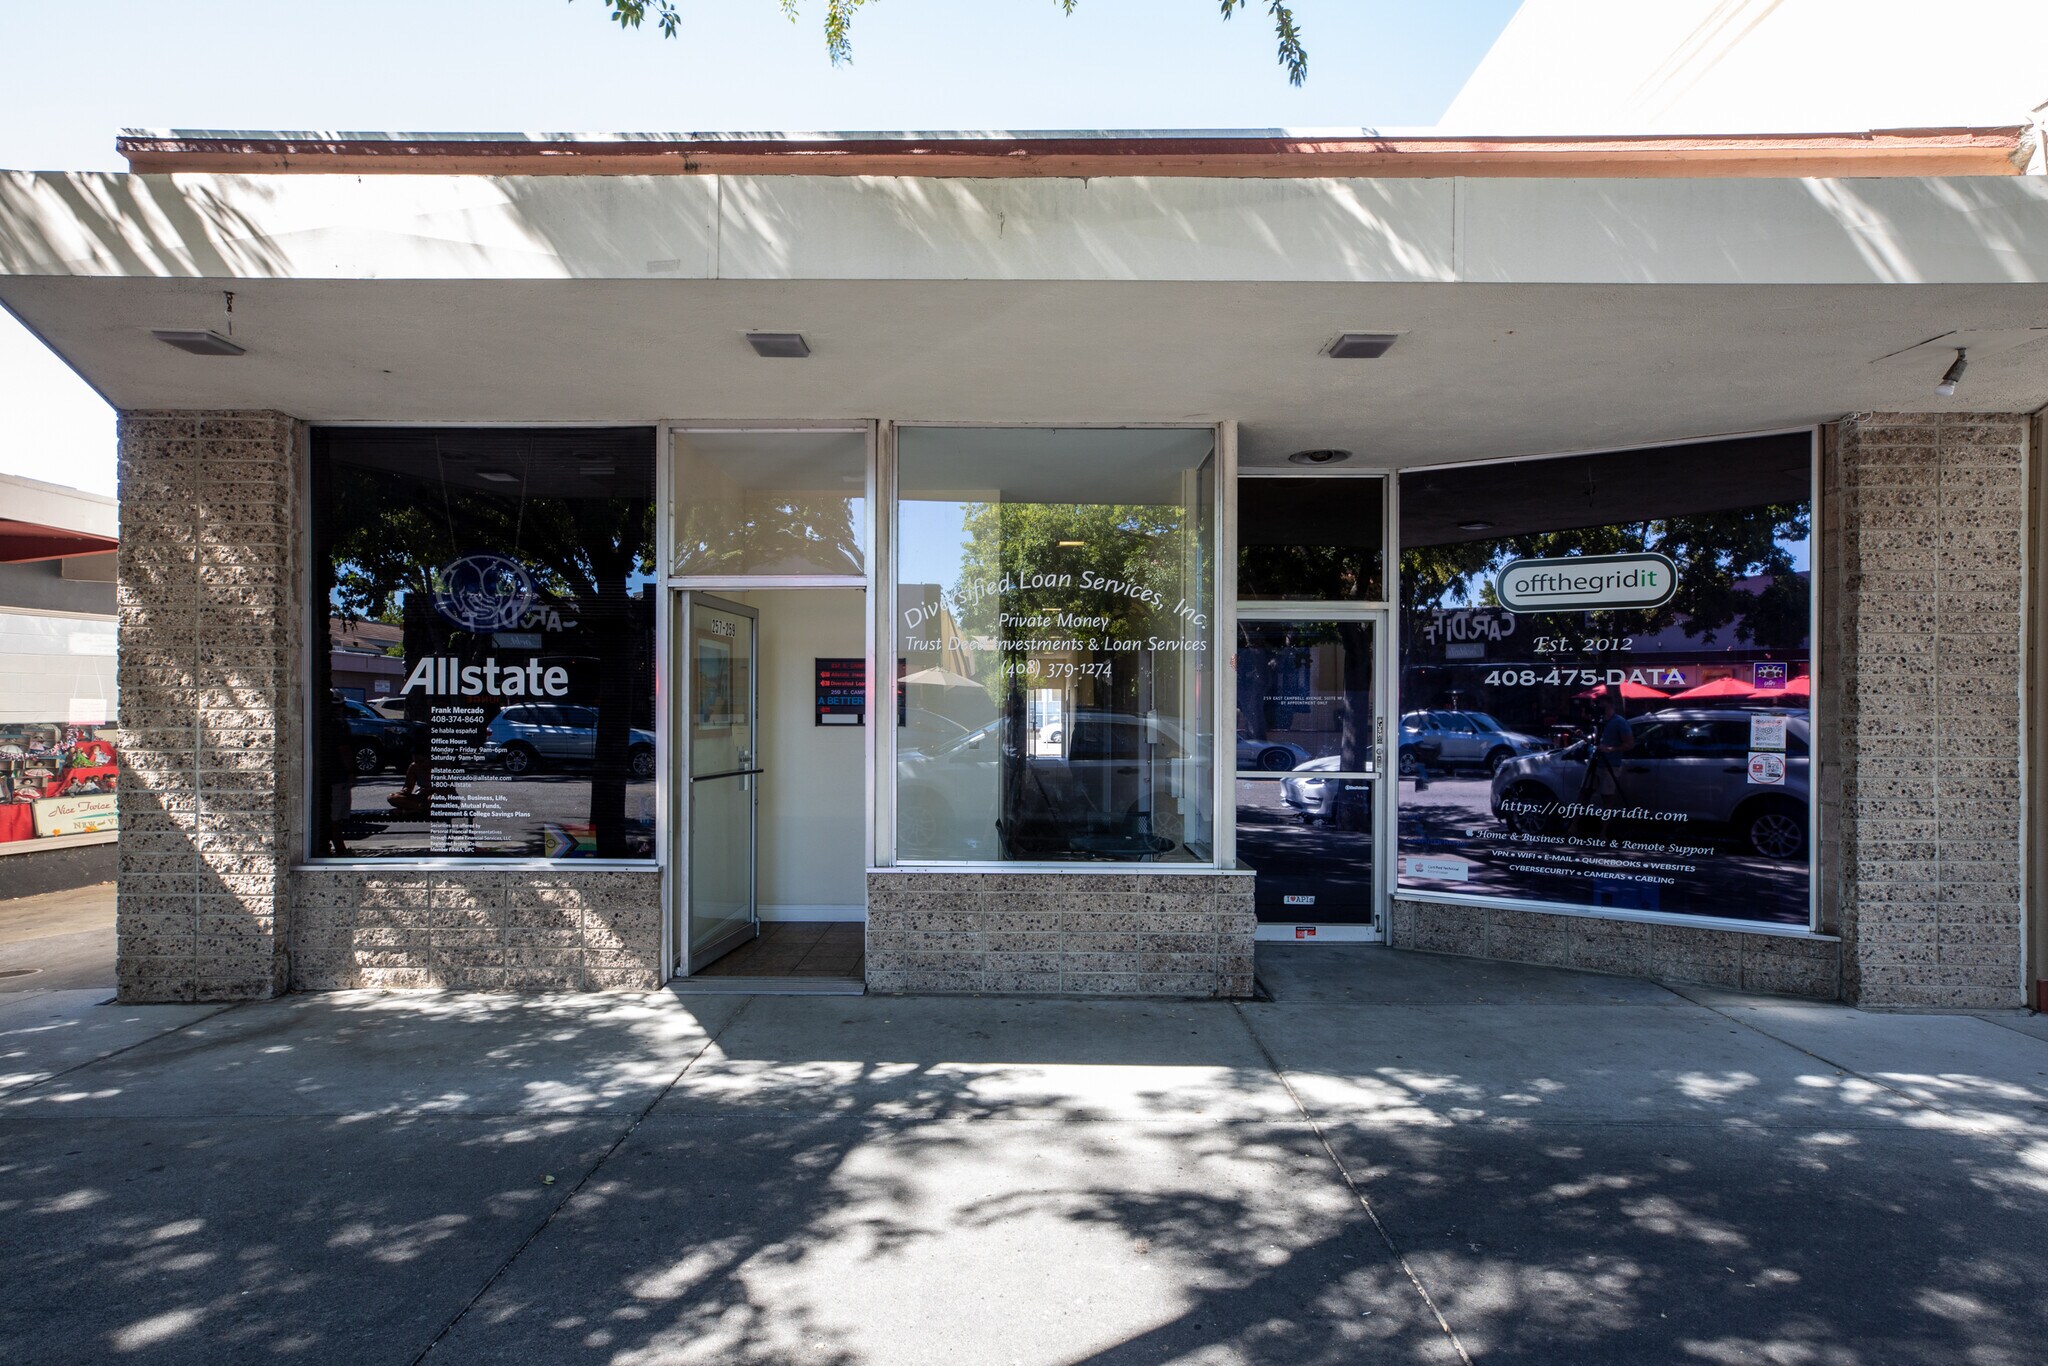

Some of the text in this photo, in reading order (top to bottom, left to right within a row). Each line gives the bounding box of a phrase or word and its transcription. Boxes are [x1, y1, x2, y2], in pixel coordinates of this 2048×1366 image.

[1515, 569, 1658, 597] offthegridit
[904, 570, 1209, 630] Diversified Loan Services, Inc.
[712, 619, 736, 637] 257-259
[999, 613, 1109, 632] Private Money
[906, 636, 942, 651] Trust
[1088, 637, 1100, 650] &
[1104, 636, 1141, 651] Loan
[1147, 636, 1207, 651] Services
[1533, 636, 1633, 652] Est. 2012
[400, 657, 569, 696] Allstate
[1000, 659, 1112, 679] (408) 379-1274
[1484, 668, 1686, 687] 408-475-DATA
[431, 706, 484, 714] Frank Mercado
[818, 697, 864, 705] A BETTER
[456, 727, 478, 735] español
[48, 801, 111, 818] Nice Twice
[1500, 799, 1689, 822] https://offthegridit.com
[1476, 830, 1714, 856] Home & Business On-Site & Remote Support
[1491, 850, 1509, 858] VPN
[1544, 854, 1573, 863] E-MAIL
[1582, 857, 1641, 868] QUICKBOOKS
[1650, 862, 1696, 873] WEBSITES
[1509, 864, 1675, 885] CYBERSECURITY CAMERAS CABLING
